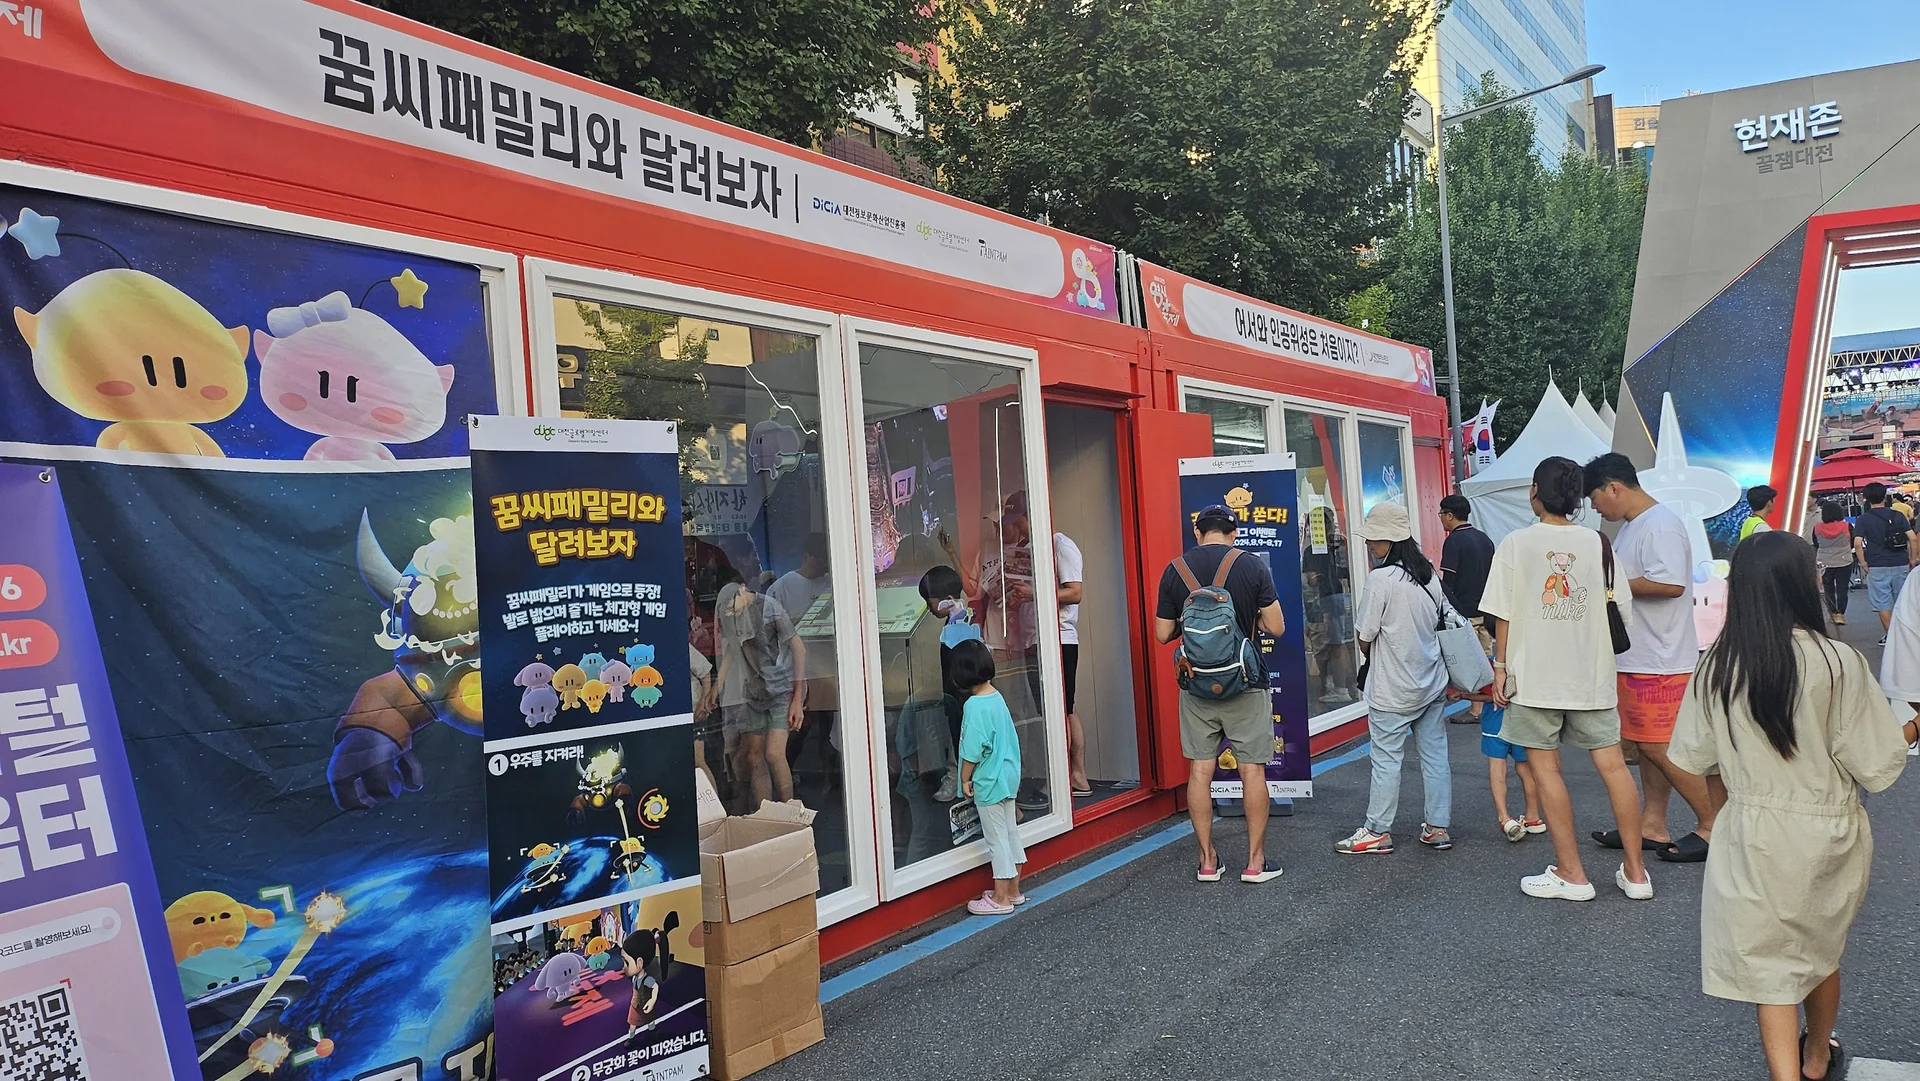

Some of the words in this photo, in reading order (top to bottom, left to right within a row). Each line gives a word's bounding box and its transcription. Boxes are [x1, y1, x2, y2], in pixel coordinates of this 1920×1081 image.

[0, 0, 43, 40] 제
[318, 27, 627, 179] 꿈씨패밀리와
[639, 127, 782, 221] 달려보자
[1734, 100, 1843, 154] 현재존
[1756, 143, 1834, 174] 꿀잼대전
[842, 204, 906, 231] 대전정보문화산업진흥원
[933, 227, 970, 244] 대전글로벌게임센터
[1234, 307, 1268, 344] 어서와
[1270, 317, 1319, 357] 인공위성은
[1320, 331, 1359, 366] 처음이지?
[558, 428, 609, 439] 대전글로벌게임센터
[490, 489, 666, 530] 꿈씨패밀리와
[1252, 507, 1288, 524] 쏜다!
[1249, 528, 1277, 538] 이벤트
[529, 529, 637, 565] 달려보자
[0, 576, 22, 600] 6
[506, 584, 584, 610] 꿈씨패밀리가
[585, 583, 633, 598] 게임으로
[634, 584, 661, 600] 등장!
[502, 611, 529, 630] 발로
[529, 605, 567, 624] 밟으며
[568, 601, 604, 619] 즐기는
[604, 600, 641, 618] 체감형
[642, 602, 667, 618] 게임
[1541, 597, 1587, 621] nike
[534, 620, 594, 643] 플레이하고
[594, 619, 639, 635] 가세요~!
[510, 750, 543, 769] 우주를
[544, 745, 584, 764] 지켜라!
[34, 924, 92, 948] 촬영해보세요!
[592, 1057, 627, 1077] 무궁화
[627, 1049, 650, 1068] 꽃이
[651, 1029, 708, 1059] 피었습니다.
